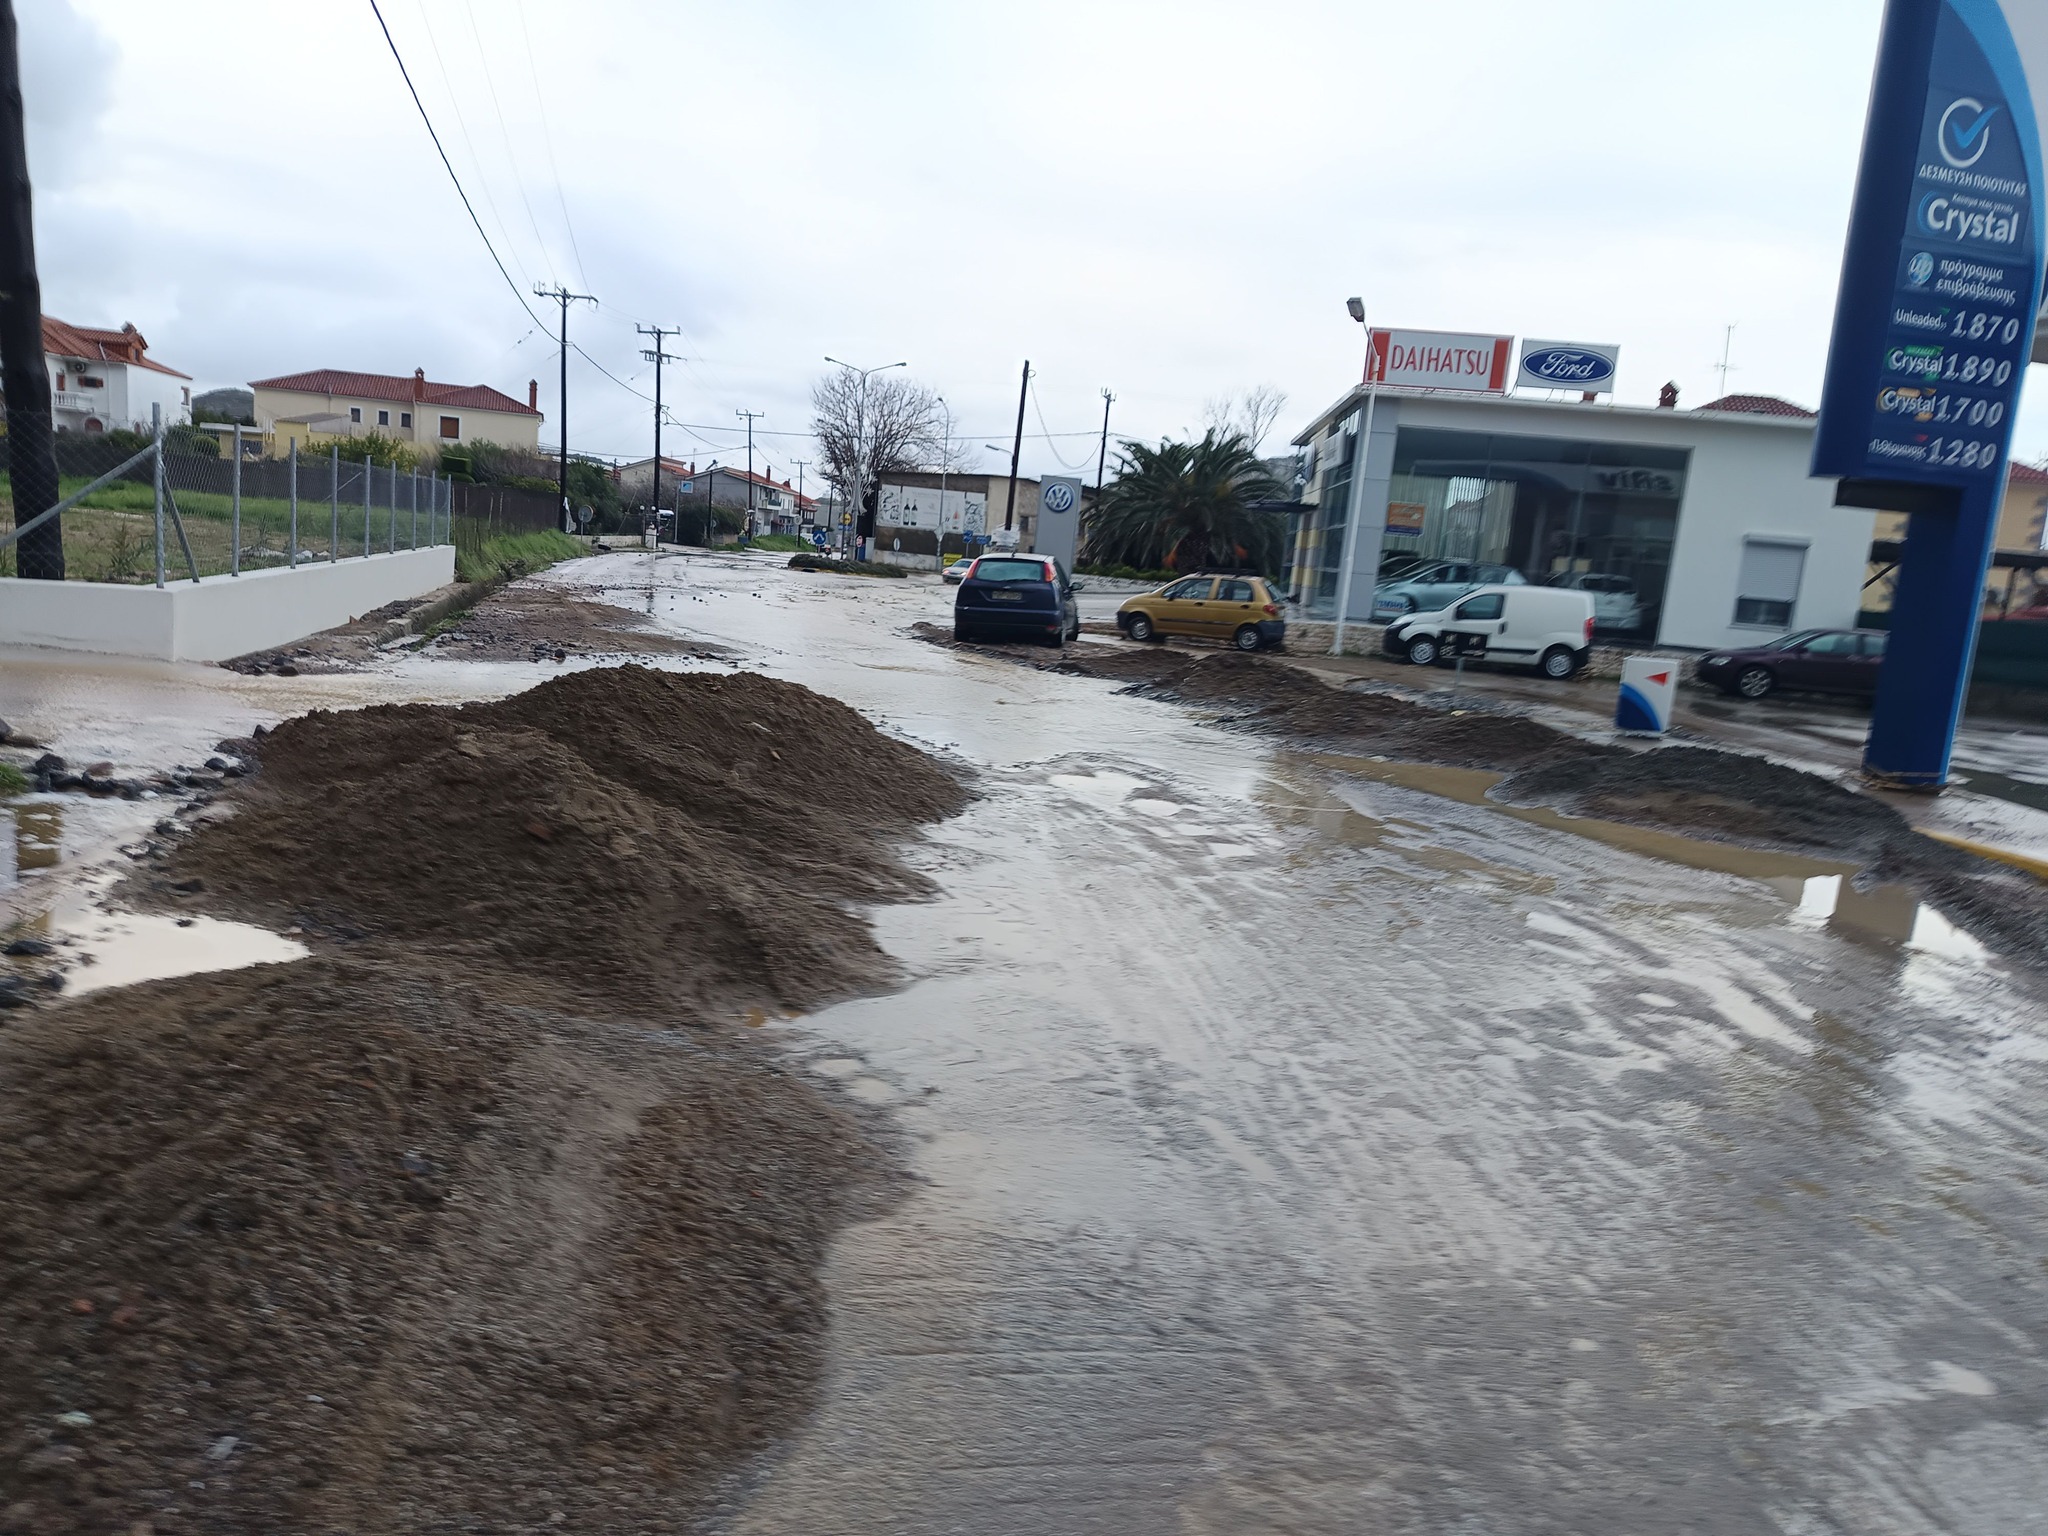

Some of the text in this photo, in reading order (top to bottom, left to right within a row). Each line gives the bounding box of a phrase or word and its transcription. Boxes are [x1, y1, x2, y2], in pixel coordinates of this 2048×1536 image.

[1918, 164, 2028, 198] ΔΕΣΜΕΥΣΗ ΠΟΙΟΤΗΤΑΣ
[1927, 198, 2019, 244] Crystal
[1939, 259, 2004, 282] πρόγραμμα
[1934, 278, 2017, 307] επιβράβευσης
[1390, 344, 1490, 376] DAIHATSU
[1540, 351, 1596, 379] Ford
[1889, 349, 1944, 375] Crystal
[1881, 390, 1937, 415] Crystal
